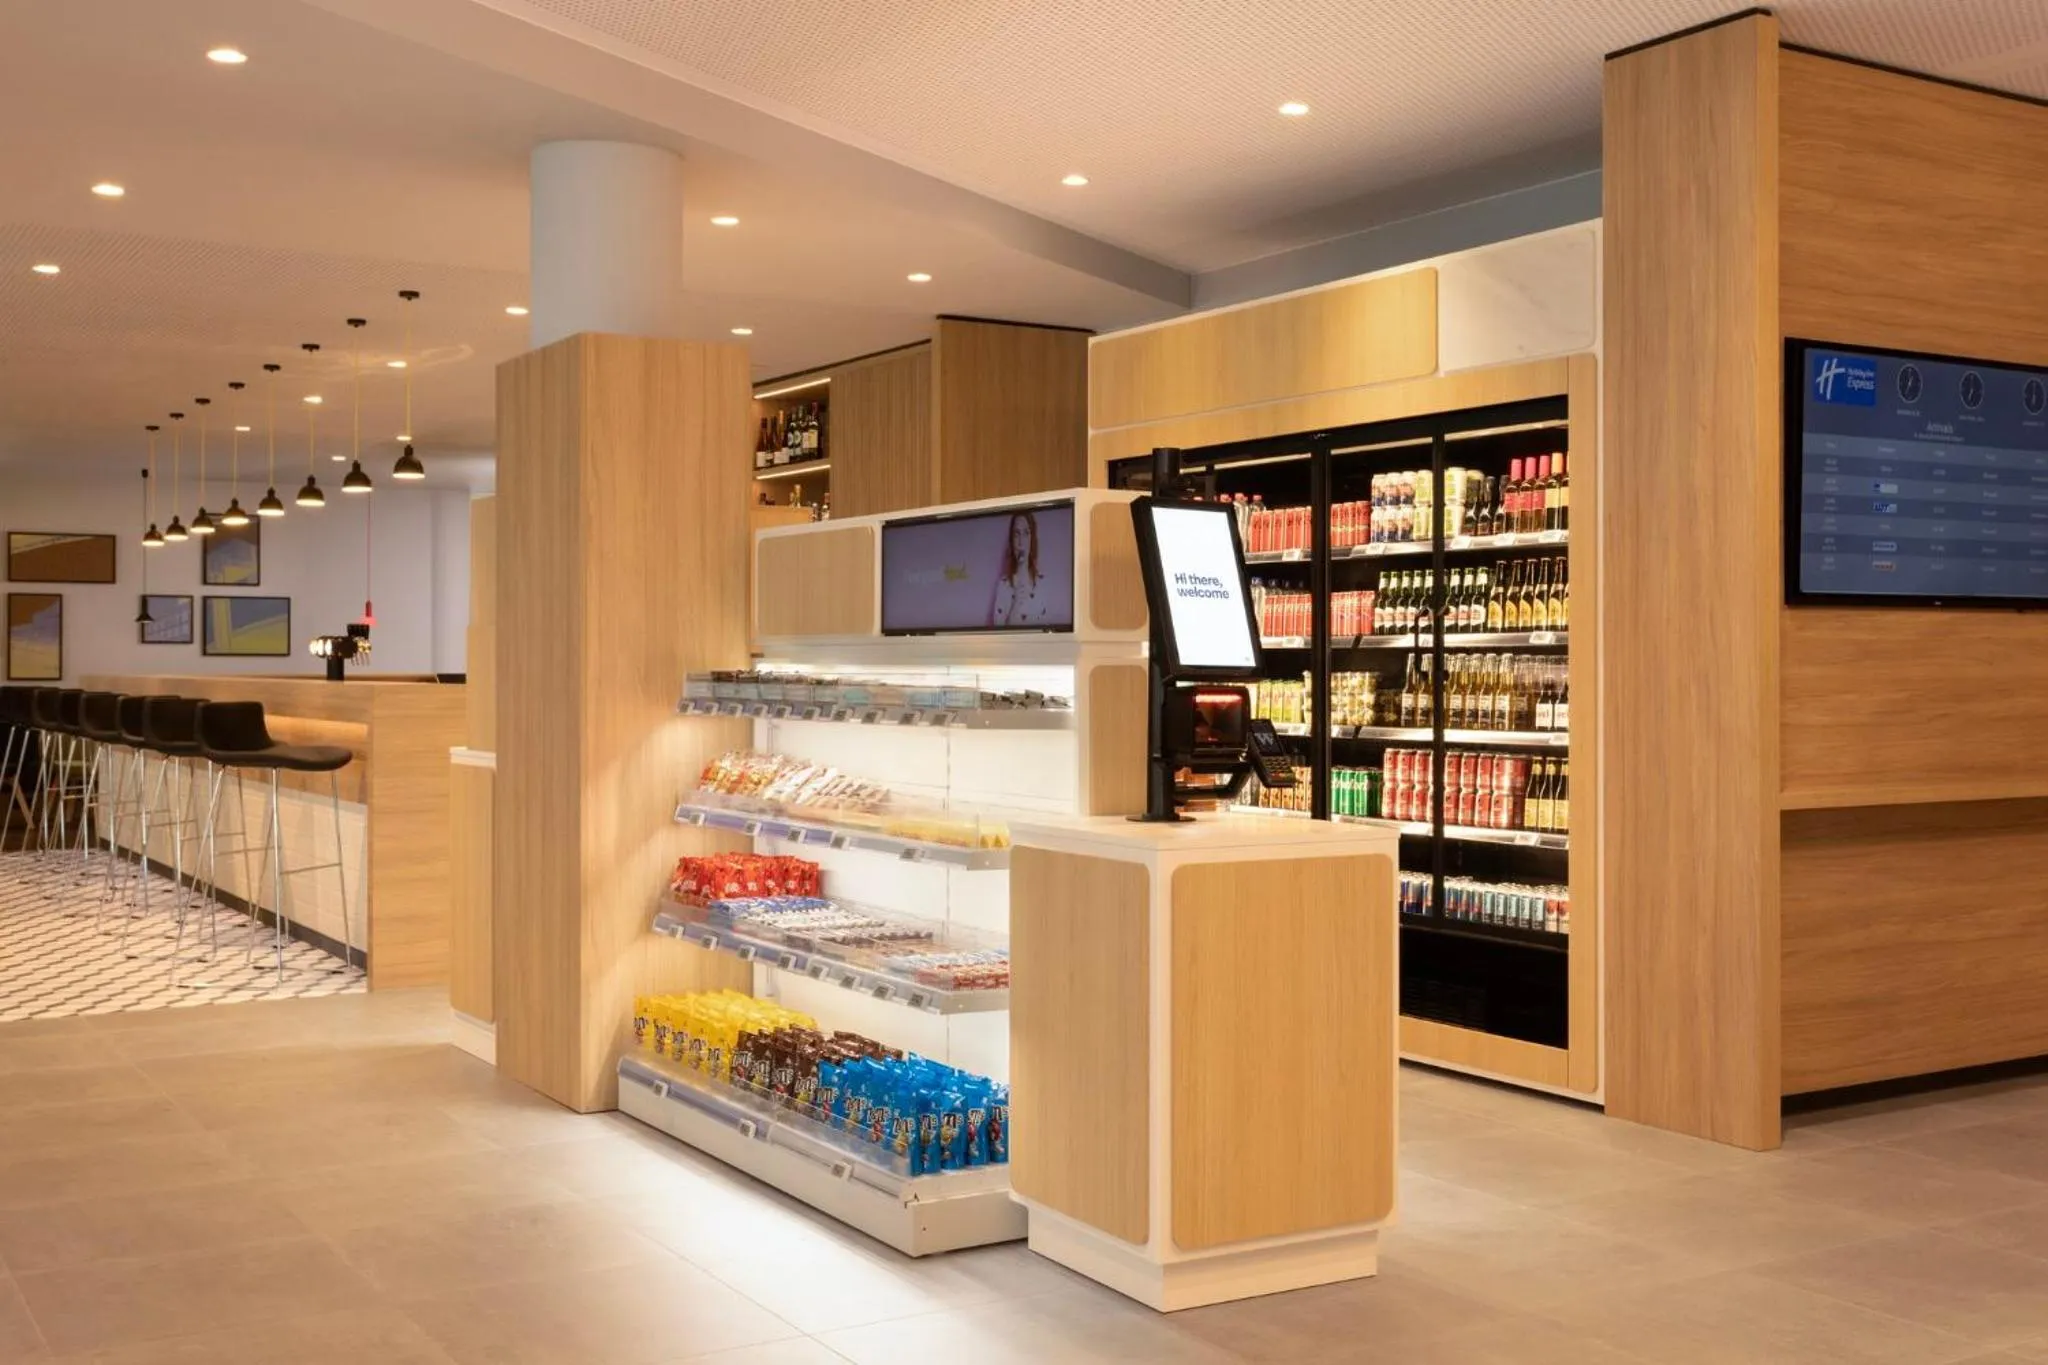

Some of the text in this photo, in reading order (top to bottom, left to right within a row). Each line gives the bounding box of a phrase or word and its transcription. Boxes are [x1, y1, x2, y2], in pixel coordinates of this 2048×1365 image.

[1174, 572, 1223, 588] Hi there,
[1176, 586, 1230, 599] welcome
